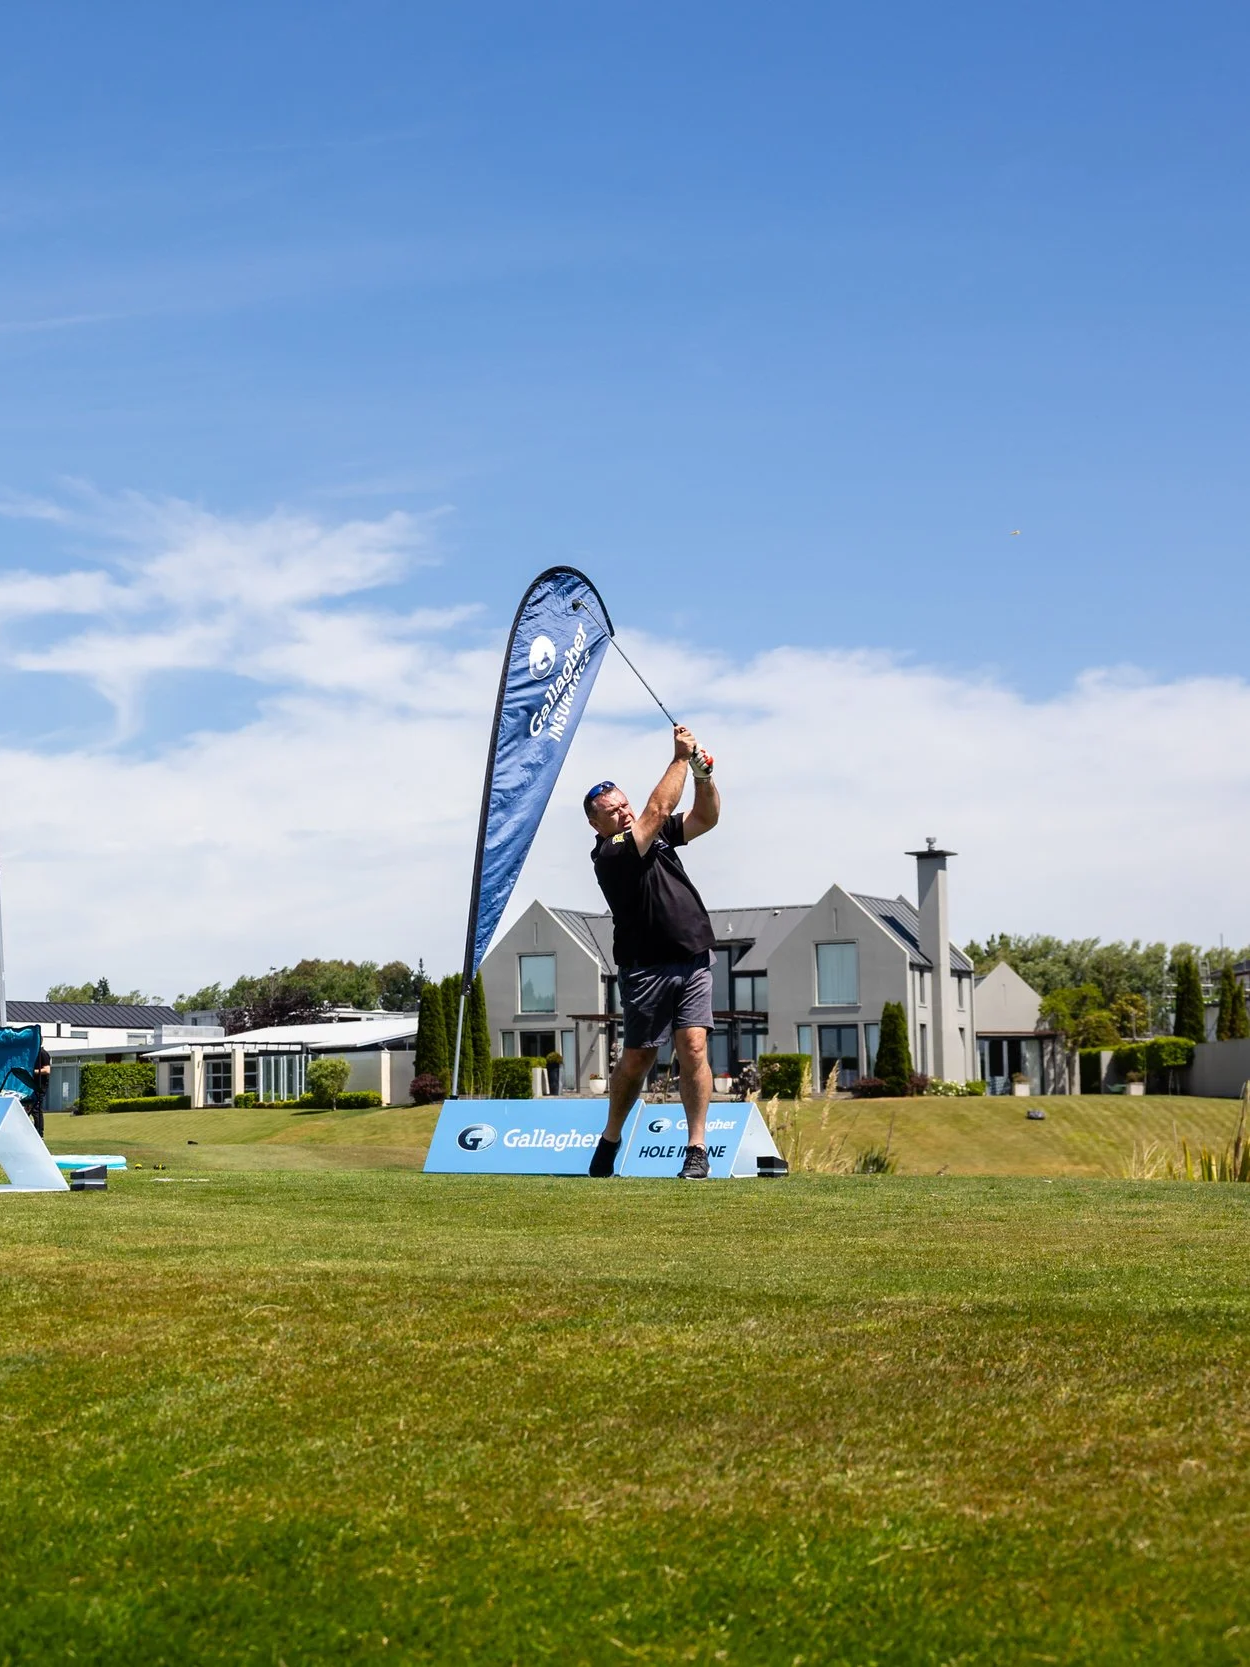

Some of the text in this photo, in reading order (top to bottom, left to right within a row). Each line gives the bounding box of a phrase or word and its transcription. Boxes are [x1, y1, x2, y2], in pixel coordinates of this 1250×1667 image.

[530, 622, 587, 737] Gallagher
[548, 648, 591, 742] INSURANCE
[638, 1145, 675, 1158] HOLE
[706, 1145, 727, 1158] NE
[676, 1118, 737, 1132] Ggher
